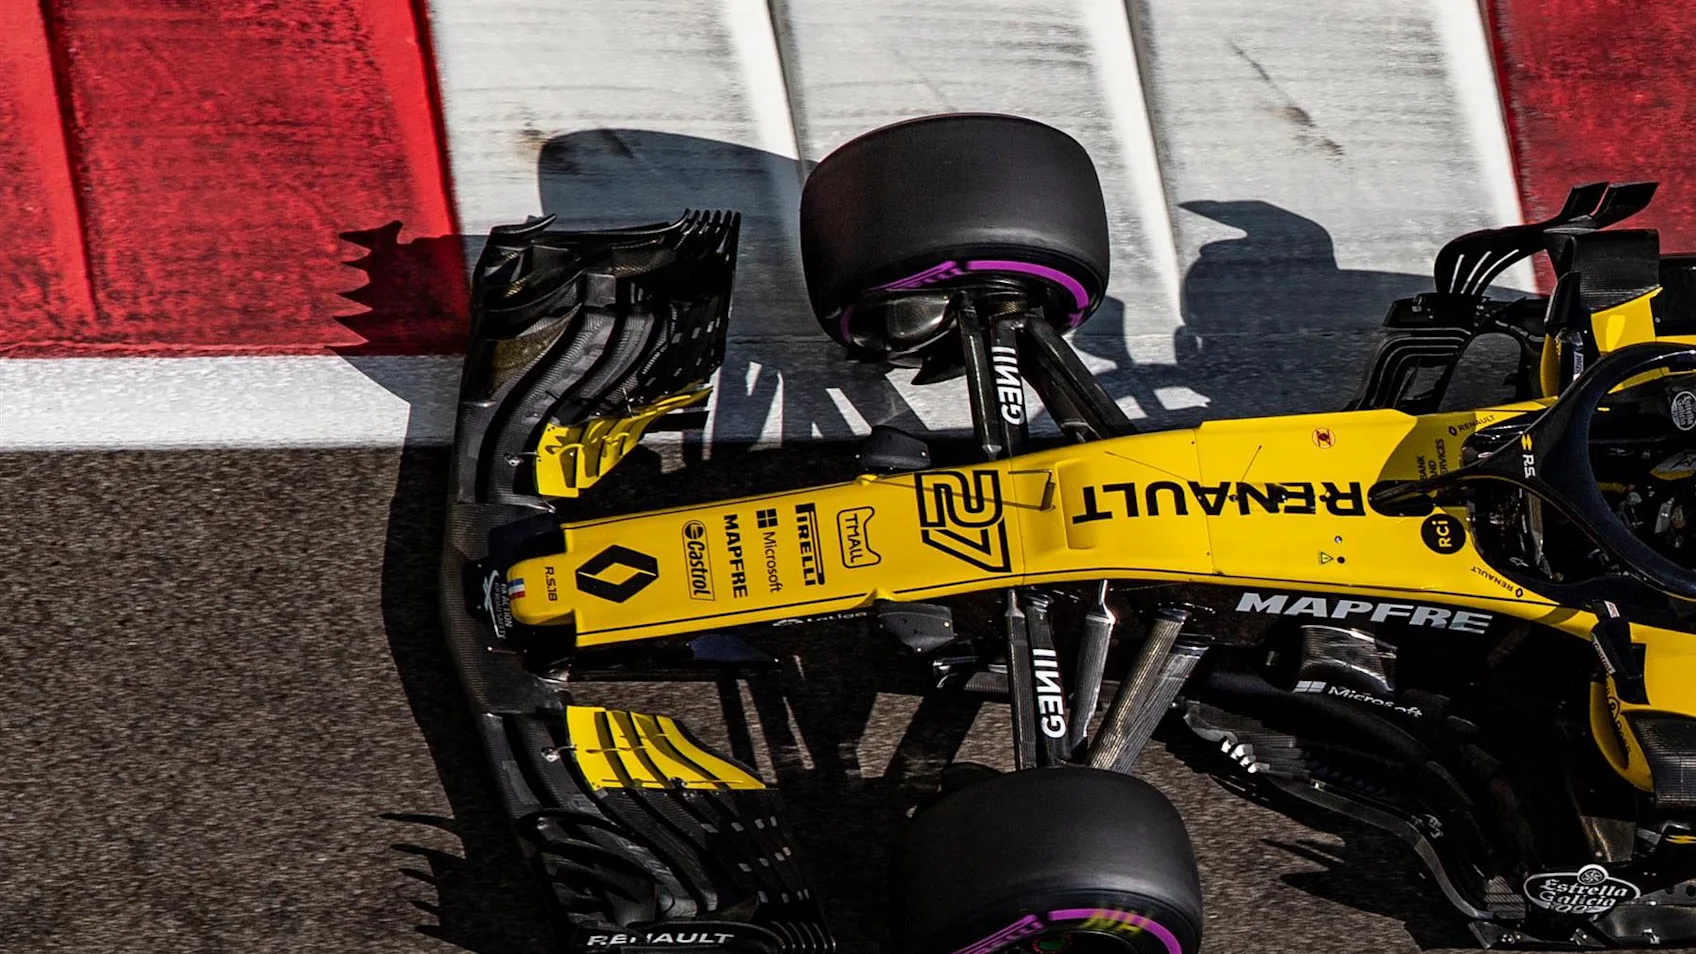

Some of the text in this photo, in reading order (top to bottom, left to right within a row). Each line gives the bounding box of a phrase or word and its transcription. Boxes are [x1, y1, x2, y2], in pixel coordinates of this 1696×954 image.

[1457, 415, 1496, 432] RENAULT
[914, 469, 1012, 573] 27
[1072, 480, 1367, 525] RENAULT
[723, 513, 748, 599] MAPFRE
[795, 502, 825, 586] PIRELLI
[845, 513, 863, 563] TMALL
[687, 540, 711, 596] Castrol
[763, 531, 783, 593] Microsoft
[1470, 565, 1515, 592] RENAULT
[1235, 592, 1493, 635] MAPFRE
[1328, 685, 1423, 719] Microsoft
[1538, 890, 1617, 907] Galicia
[1539, 878, 1629, 897] Estrella
